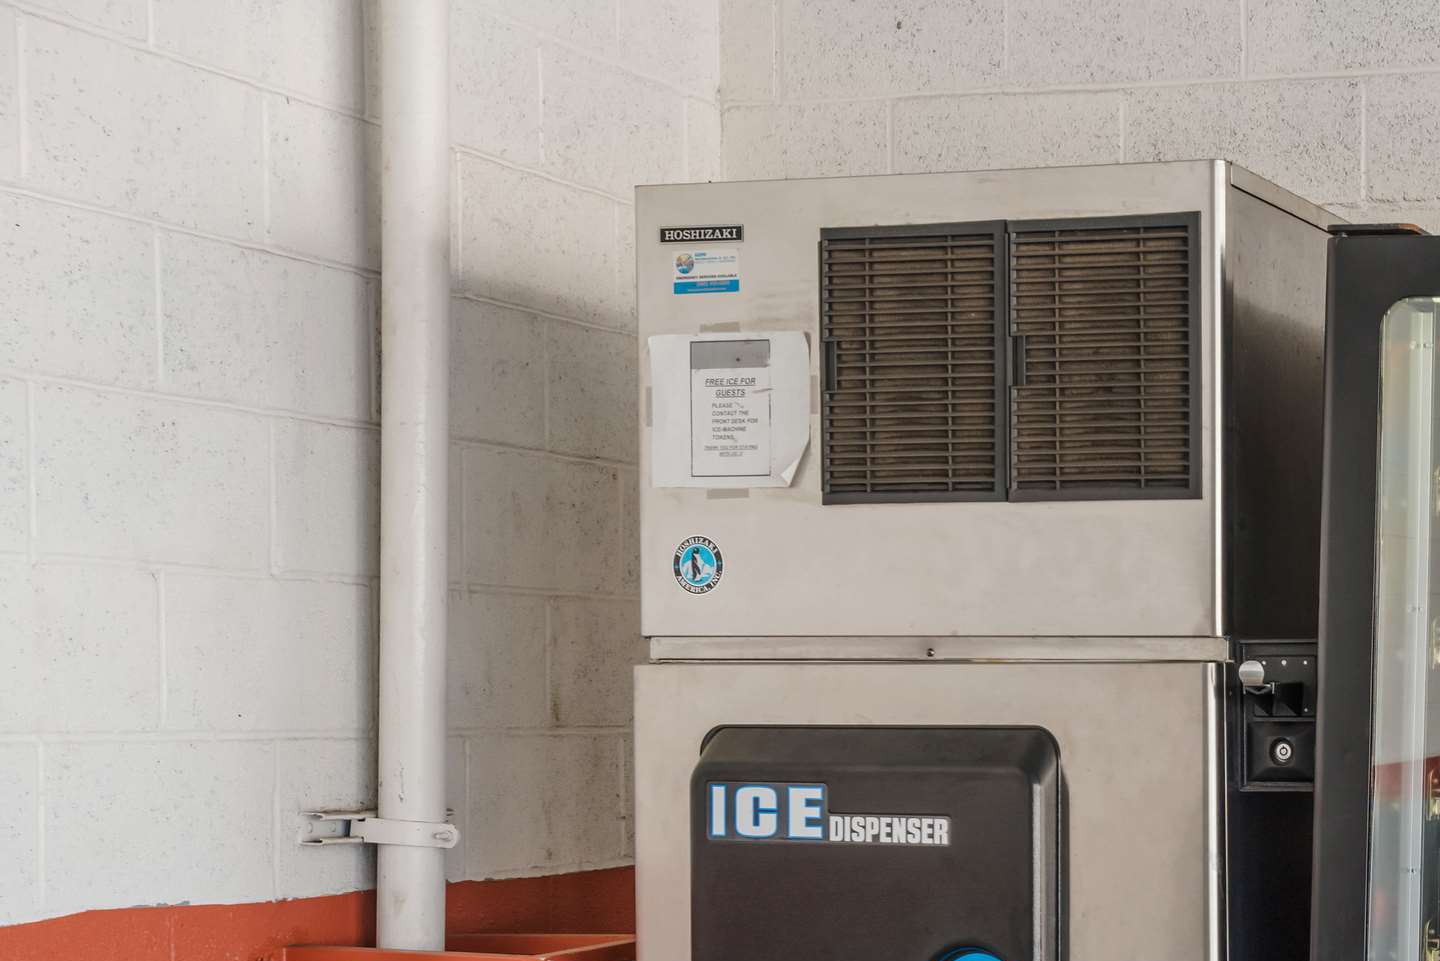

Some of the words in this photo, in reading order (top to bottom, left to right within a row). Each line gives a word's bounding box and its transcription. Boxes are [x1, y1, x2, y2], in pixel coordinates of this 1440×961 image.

[664, 228, 737, 241] HOSHIZAKI
[704, 378, 726, 387] FREE
[726, 378, 740, 386] ICE
[740, 377, 757, 386] FOR
[715, 389, 746, 398] GUESTS
[675, 537, 719, 557] HOSHIZAKI
[710, 783, 825, 840] ICE
[829, 814, 951, 845] DISPENSER
